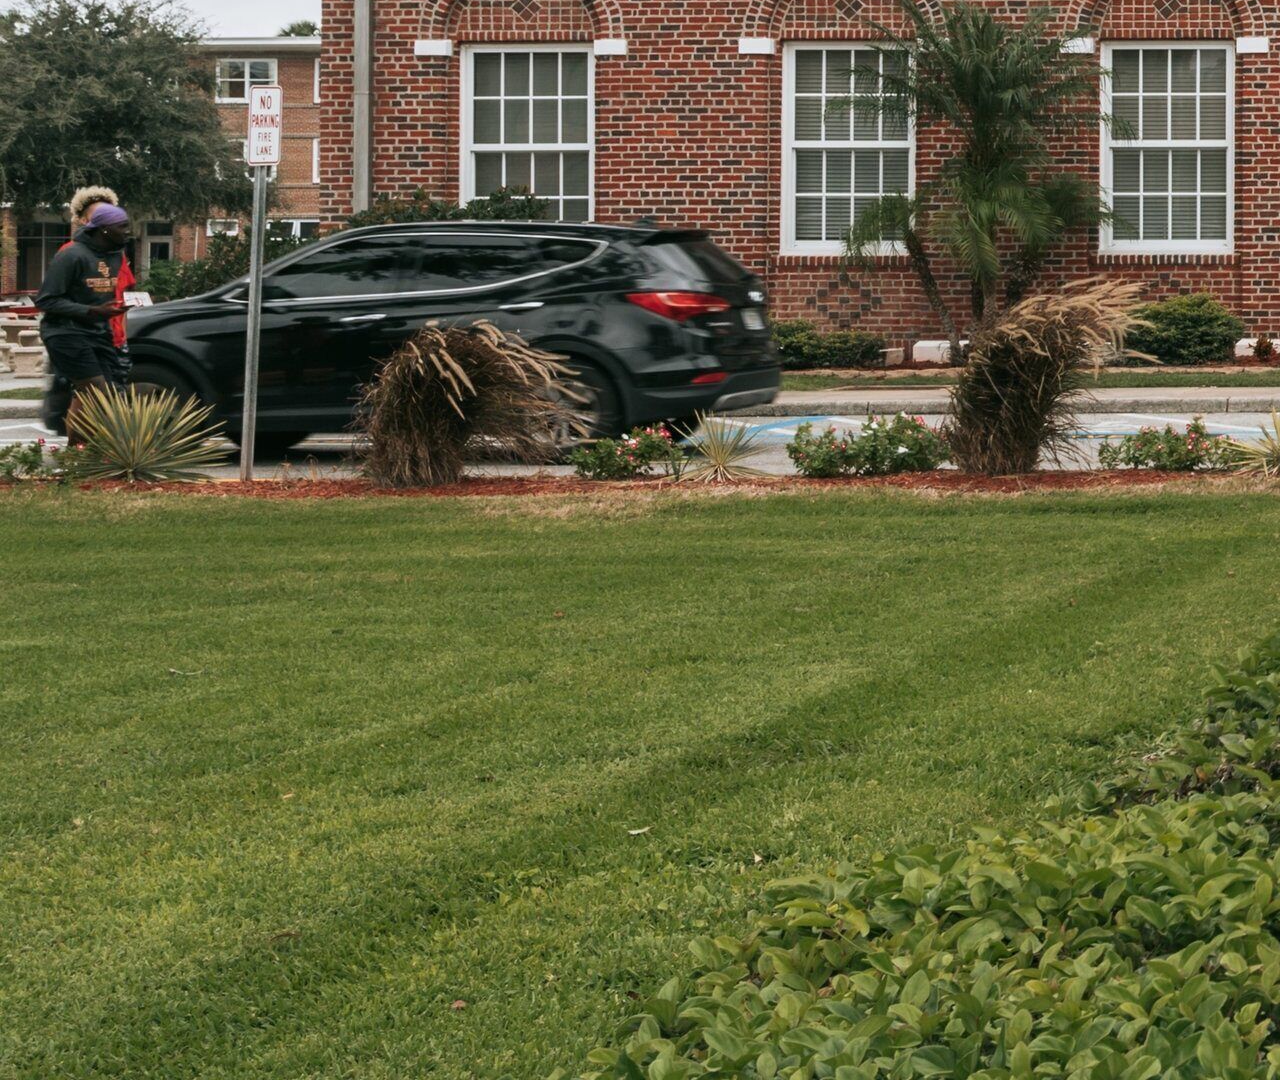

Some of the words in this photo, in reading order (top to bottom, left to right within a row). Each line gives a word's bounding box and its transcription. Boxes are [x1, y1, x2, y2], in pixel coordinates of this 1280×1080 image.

[260, 95, 272, 110] NO
[251, 113, 279, 128] PARKING
[257, 131, 272, 142] FIRE
[256, 145, 273, 156] LANE
